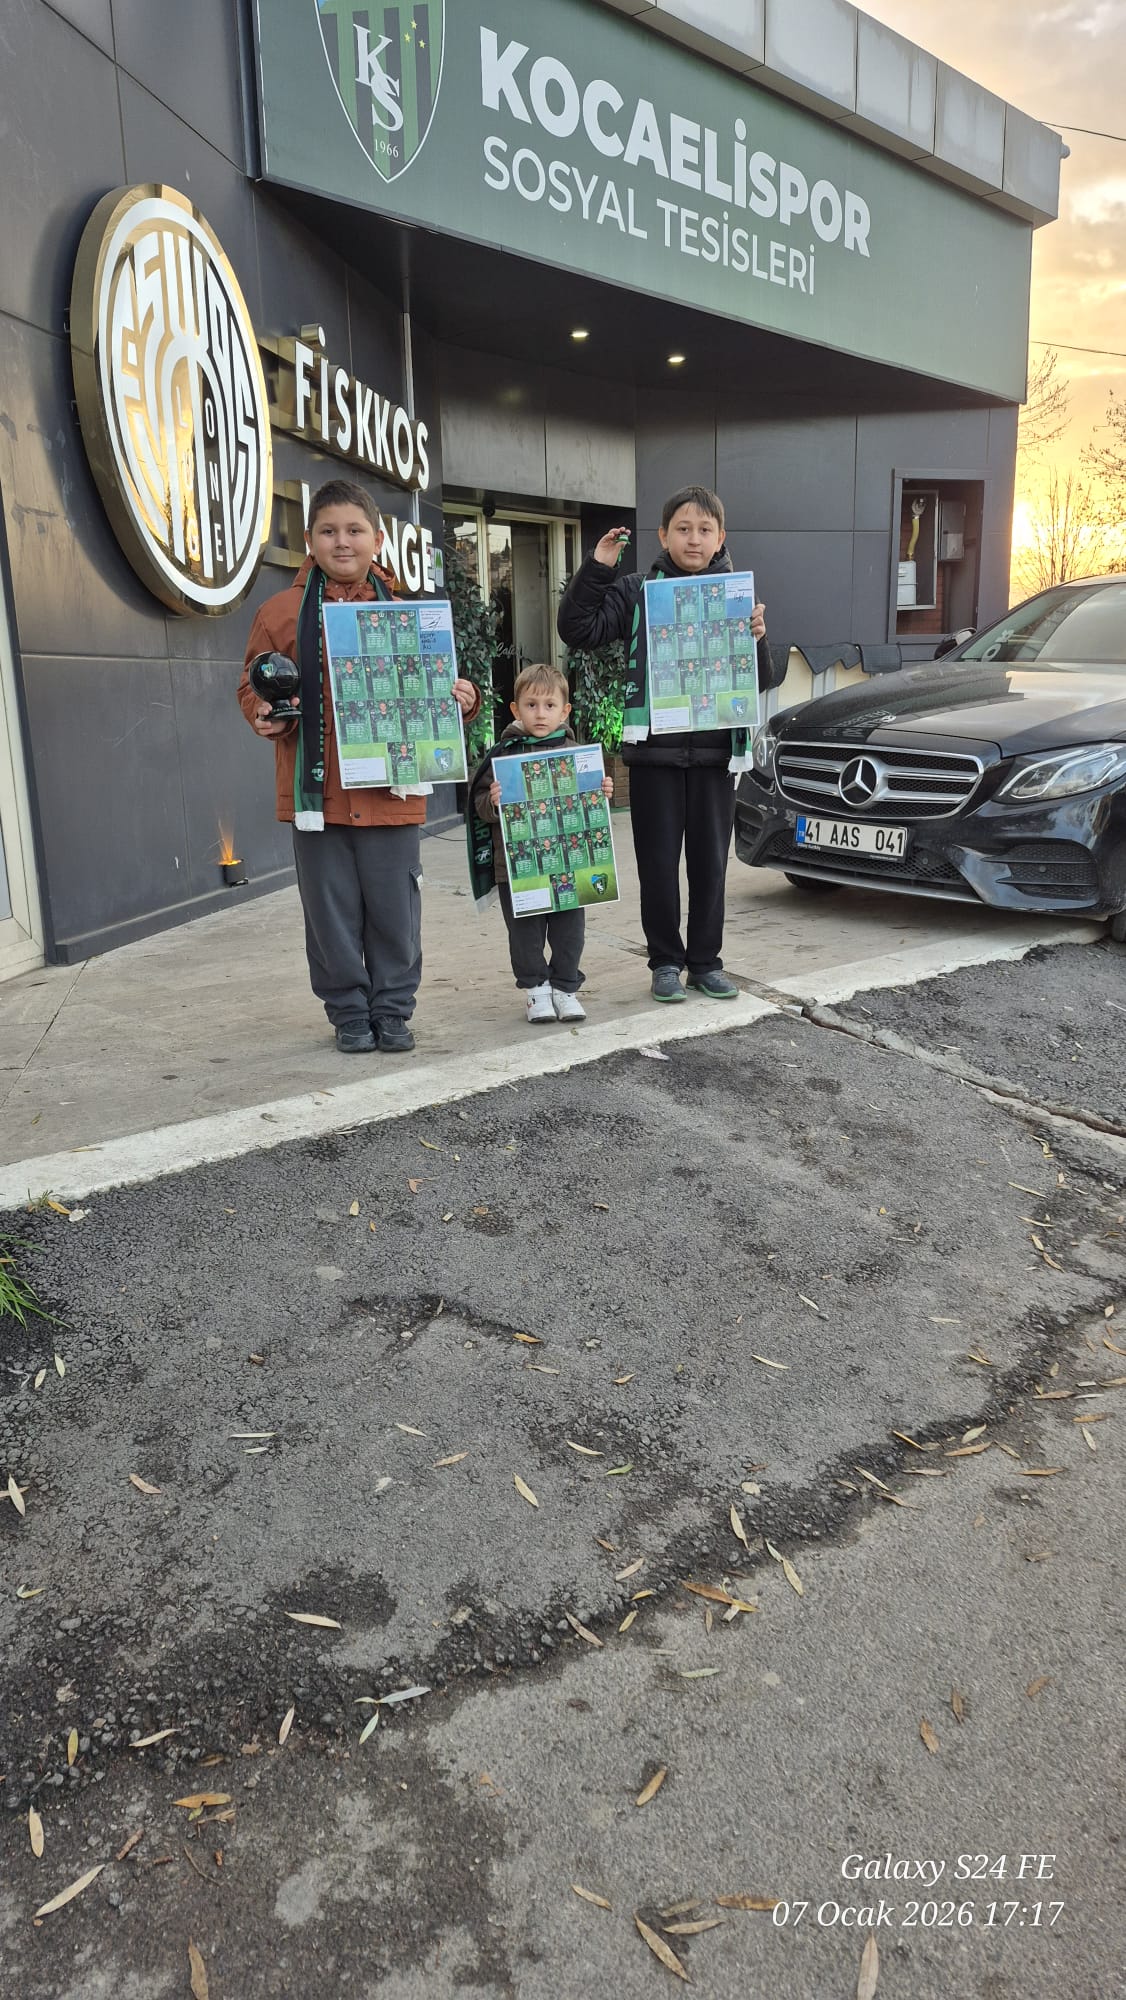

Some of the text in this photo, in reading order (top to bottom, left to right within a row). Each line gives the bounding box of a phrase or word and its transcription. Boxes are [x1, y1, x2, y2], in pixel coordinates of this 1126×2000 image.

[375, 138, 399, 159] 1966
[480, 25, 871, 258] KOCAELİSPOR
[483, 135, 815, 295] SOSYAL TESİSLERİ
[295, 325, 430, 490] FİSKKOS
[301, 482, 436, 593] NGE
[806, 821, 903, 854] 41 AAS 041
